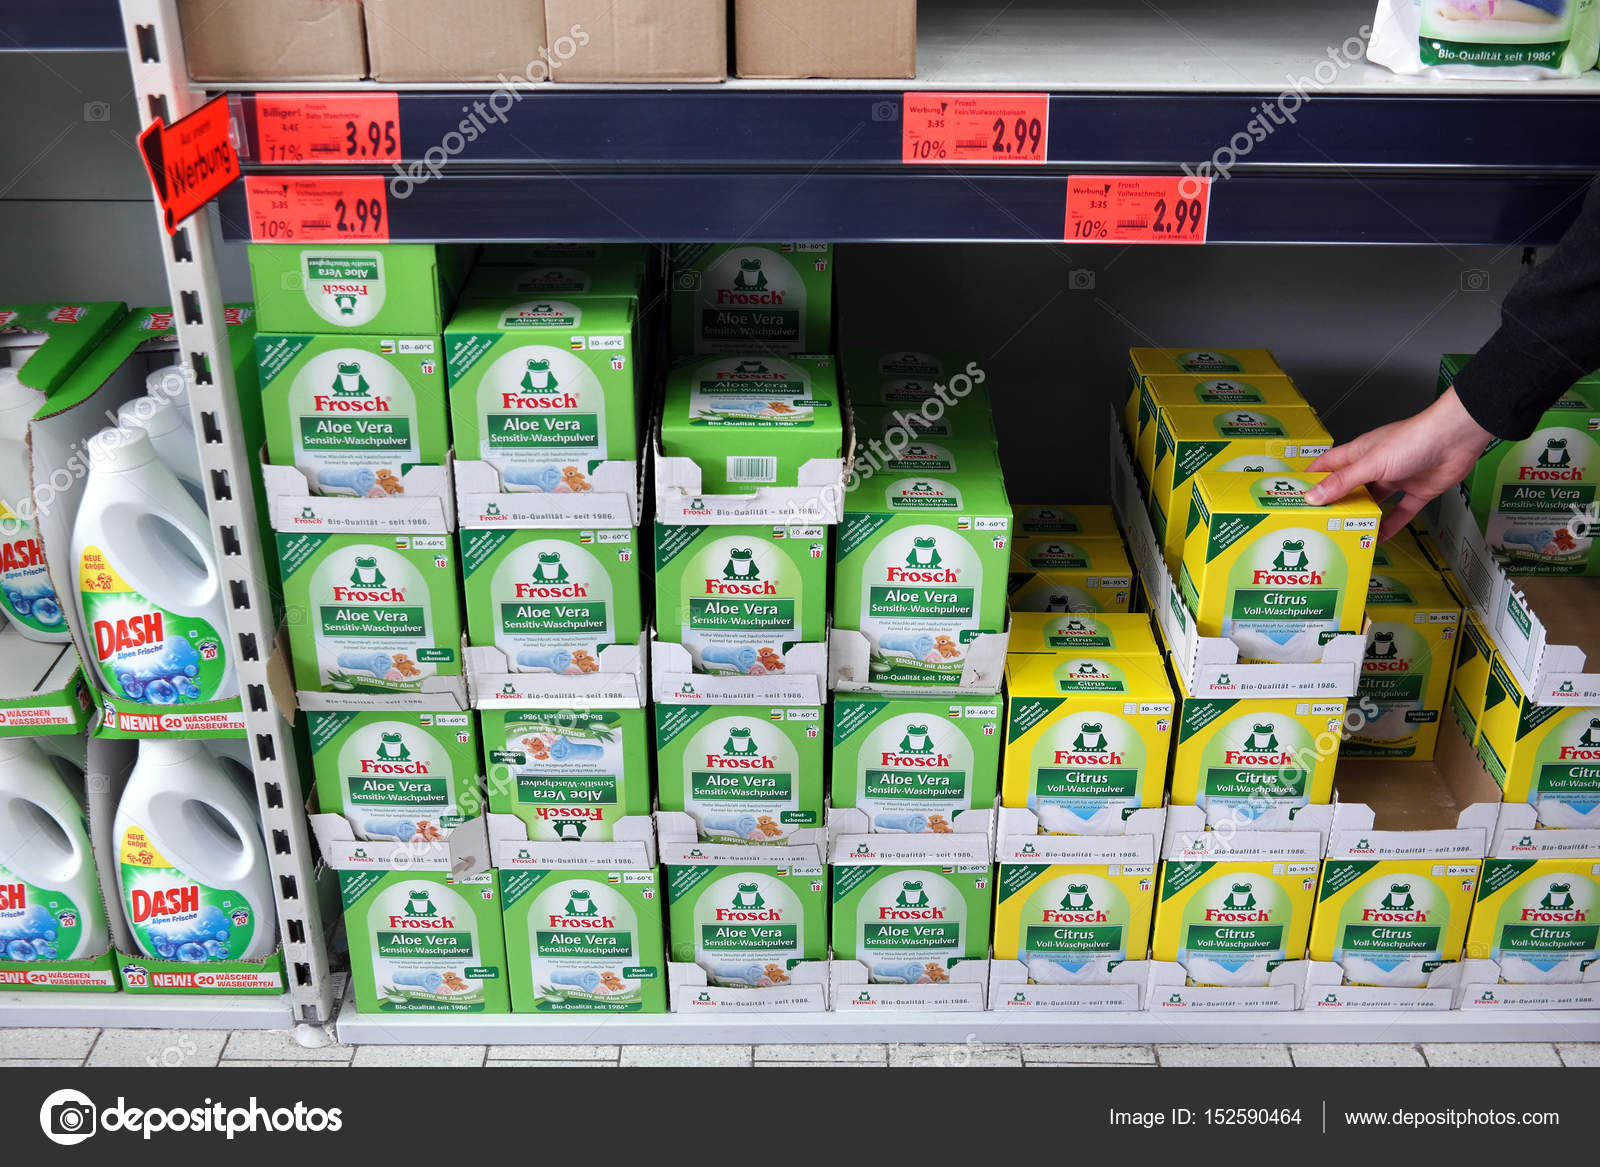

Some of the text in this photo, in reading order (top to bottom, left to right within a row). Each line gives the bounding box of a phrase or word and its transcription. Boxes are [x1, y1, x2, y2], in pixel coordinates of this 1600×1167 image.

[1438, 48, 1501, 61] Bio-Qualität
[1505, 52, 1522, 61] seit
[346, 121, 396, 156] 3.95
[992, 118, 1041, 154] 2.99
[269, 144, 303, 162] 11%
[912, 141, 946, 159] 10%
[168, 142, 231, 198] Werbung
[1117, 190, 1166, 198] Vollwaschmittel
[335, 198, 381, 232] 2.99
[1153, 199, 1200, 233] 2.99
[260, 221, 293, 238] 10%
[1074, 220, 1108, 238] 10%
[717, 289, 783, 305] Frosch
[716, 312, 785, 324] Aloe Vera
[314, 395, 390, 411] Frosch
[502, 393, 578, 409] Frosch
[316, 421, 393, 434] Aloe Vera
[503, 418, 581, 431] Aloe Vera
[304, 436, 408, 446] Sensitiv-Waschpulver
[491, 433, 595, 444] Sensitiv-Waschpulver
[1518, 466, 1583, 481] Frosch
[1514, 487, 1581, 499] Aloe Vera
[886, 567, 957, 583] Frosch
[1252, 570, 1322, 585] Frosch
[515, 583, 587, 598] Frosch
[705, 579, 776, 595] Frosch
[333, 587, 405, 602] Frosch
[885, 590, 958, 602] Aloe Vera
[1263, 593, 1307, 605] Citrus
[516, 606, 590, 618] Aloe Vera
[704, 602, 778, 615] Aloe Vera
[872, 604, 970, 614] Sensitiv-Waschpulver
[1243, 607, 1323, 617] Voll-Waschpulver
[336, 610, 409, 622] Aloe Vera
[692, 616, 791, 627] Sensitiv-Waschpulver
[324, 624, 423, 634] Sensitiv-Waschpulver
[504, 620, 603, 629] Sensitiv-Waschpulver
[93, 612, 165, 661] DASH
[117, 644, 164, 660] Alpen Frische
[204, 649, 215, 658] 20
[6, 709, 51, 717] WÄSCHEN
[182, 714, 228, 723] WÄSCHEN
[9, 716, 68, 725] WASBEURTEN
[119, 713, 182, 731] NEW! 20
[185, 721, 245, 730] WASBEURTEN
[706, 754, 775, 768] Frosch
[881, 752, 949, 767] Frosch
[1053, 751, 1122, 765] Frosch
[1224, 751, 1292, 765] Frosch
[360, 760, 428, 774] Frosch
[706, 776, 776, 787] Aloe Vera
[880, 773, 950, 785] Aloe Vera
[1065, 772, 1108, 784] Citrus
[1235, 772, 1278, 783] Citrus
[362, 780, 432, 792] Aloe Vera
[867, 786, 962, 795] Sensitiv-Waschpulver
[1047, 785, 1125, 794] Voll-Waschpulver
[1217, 784, 1294, 794] Voll-Waschpulver
[352, 793, 446, 803] Sensitiv-Waschpulver
[533, 790, 602, 800] Aloe Vera
[694, 788, 788, 797] Sensitiv-Waschpulver
[536, 808, 603, 821] Frosch
[127, 833, 145, 841] NEUE
[131, 885, 199, 923] DASH
[1, 910, 25, 918] Frische
[172, 913, 198, 922] Frische
[716, 909, 781, 921] Frosch
[879, 907, 944, 919] Frosch
[1042, 910, 1108, 923] Frosch
[1205, 909, 1269, 922] Frosch
[1362, 909, 1426, 922] Frosch
[1520, 909, 1586, 922] Frosch
[62, 918, 74, 926] 20
[235, 916, 246, 925] 20
[389, 916, 455, 928] Frosch
[549, 915, 614, 928] Frosch
[716, 928, 782, 938] Aloe Vera
[878, 926, 944, 936] Aloe Vera
[1054, 929, 1094, 940] Citrus
[1215, 928, 1255, 939] Citrus
[1372, 928, 1412, 939] Citrus
[1530, 928, 1571, 939] Citrus
[391, 935, 457, 945] Aloe Vera
[550, 934, 617, 945] Aloe Vera
[704, 939, 795, 947] Sensitiv-Waschpulver
[866, 938, 956, 946] Sensitiv-Waschpulver
[1036, 940, 1110, 949] Voll-Waschpulver
[1197, 940, 1270, 948] Voll-Waschpulver
[1353, 940, 1427, 948] Voll-Waschpulver
[1511, 939, 1585, 947] Voll-Waschpulver
[381, 946, 470, 955] Sensitiv-Waschpulver
[540, 946, 630, 954] Sensitiv-Waschpulver
[31, 974, 47, 982] 20
[127, 974, 146, 985] 20
[152, 973, 215, 987] NEW! 20
[217, 980, 274, 988] WASBEURTEN
